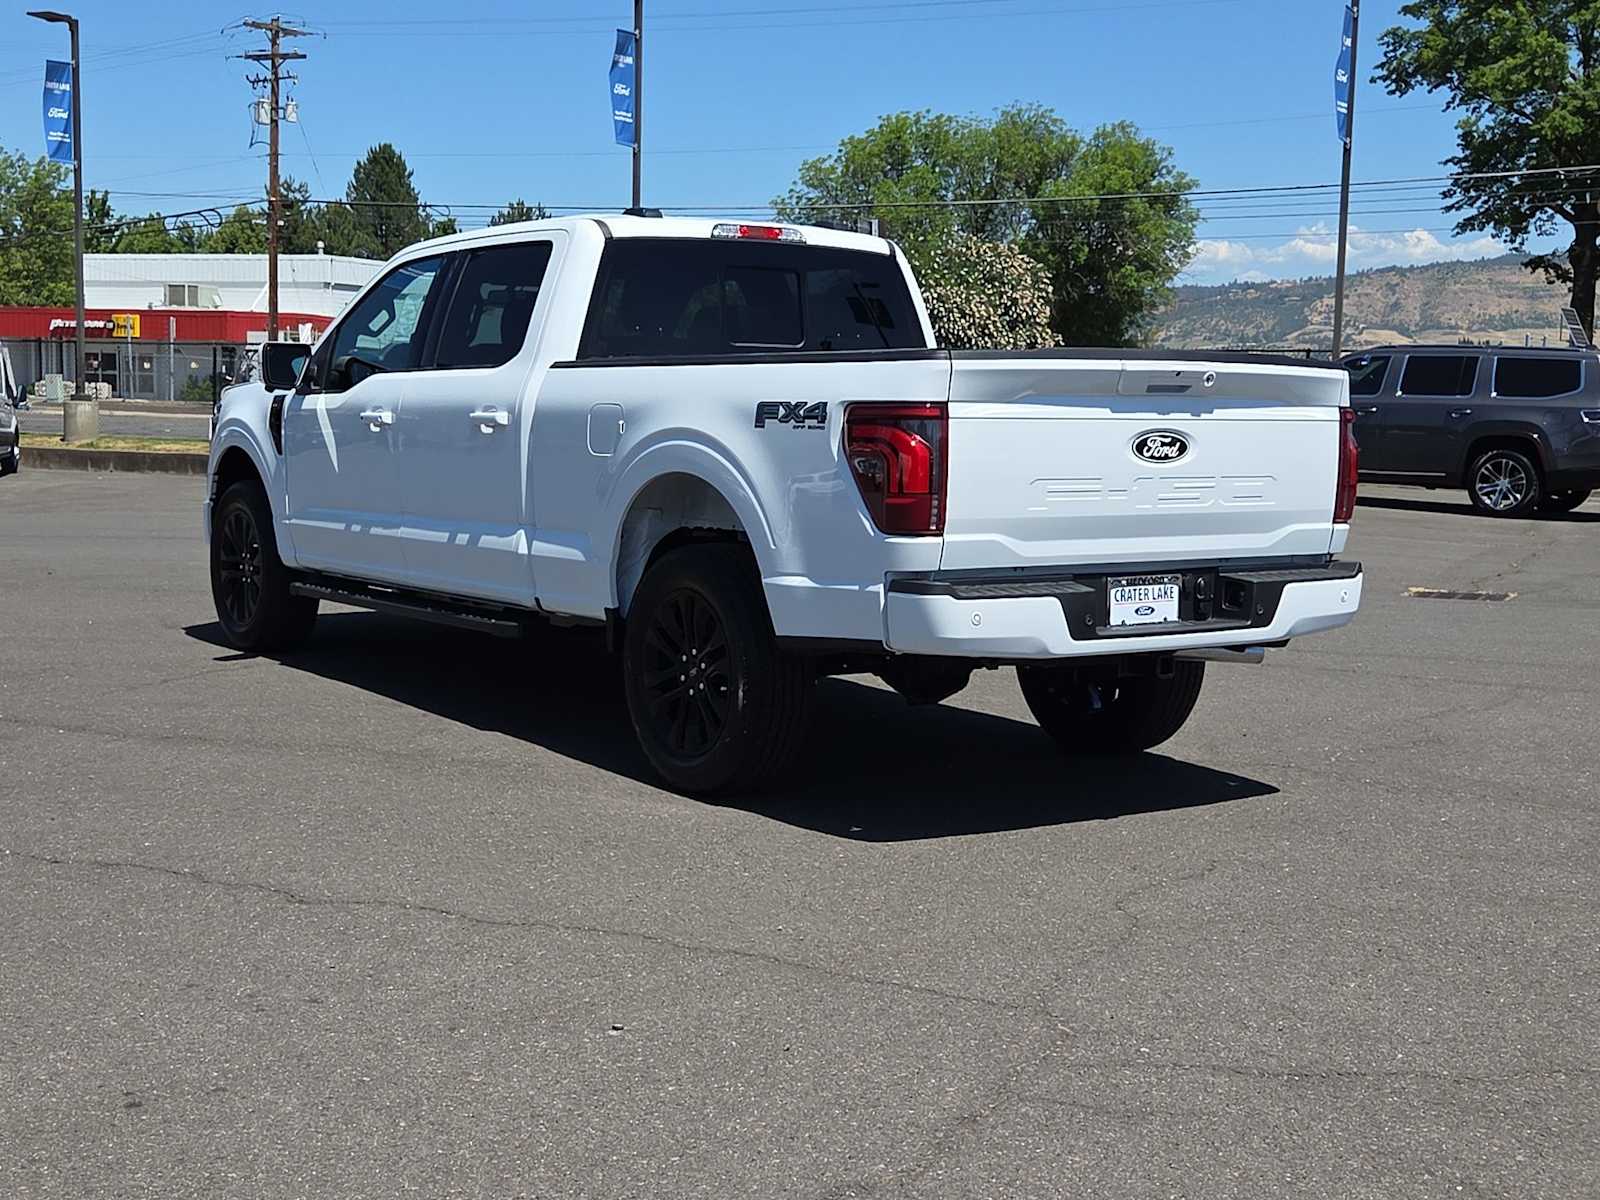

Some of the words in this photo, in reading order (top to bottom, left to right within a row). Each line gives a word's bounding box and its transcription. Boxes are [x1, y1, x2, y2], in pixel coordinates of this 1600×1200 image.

[48, 106, 69, 119] Ford
[754, 401, 828, 429] FX4
[1142, 436, 1182, 458] Ford
[1114, 587, 1150, 602] CRATER
[1152, 585, 1175, 600] LAKE
